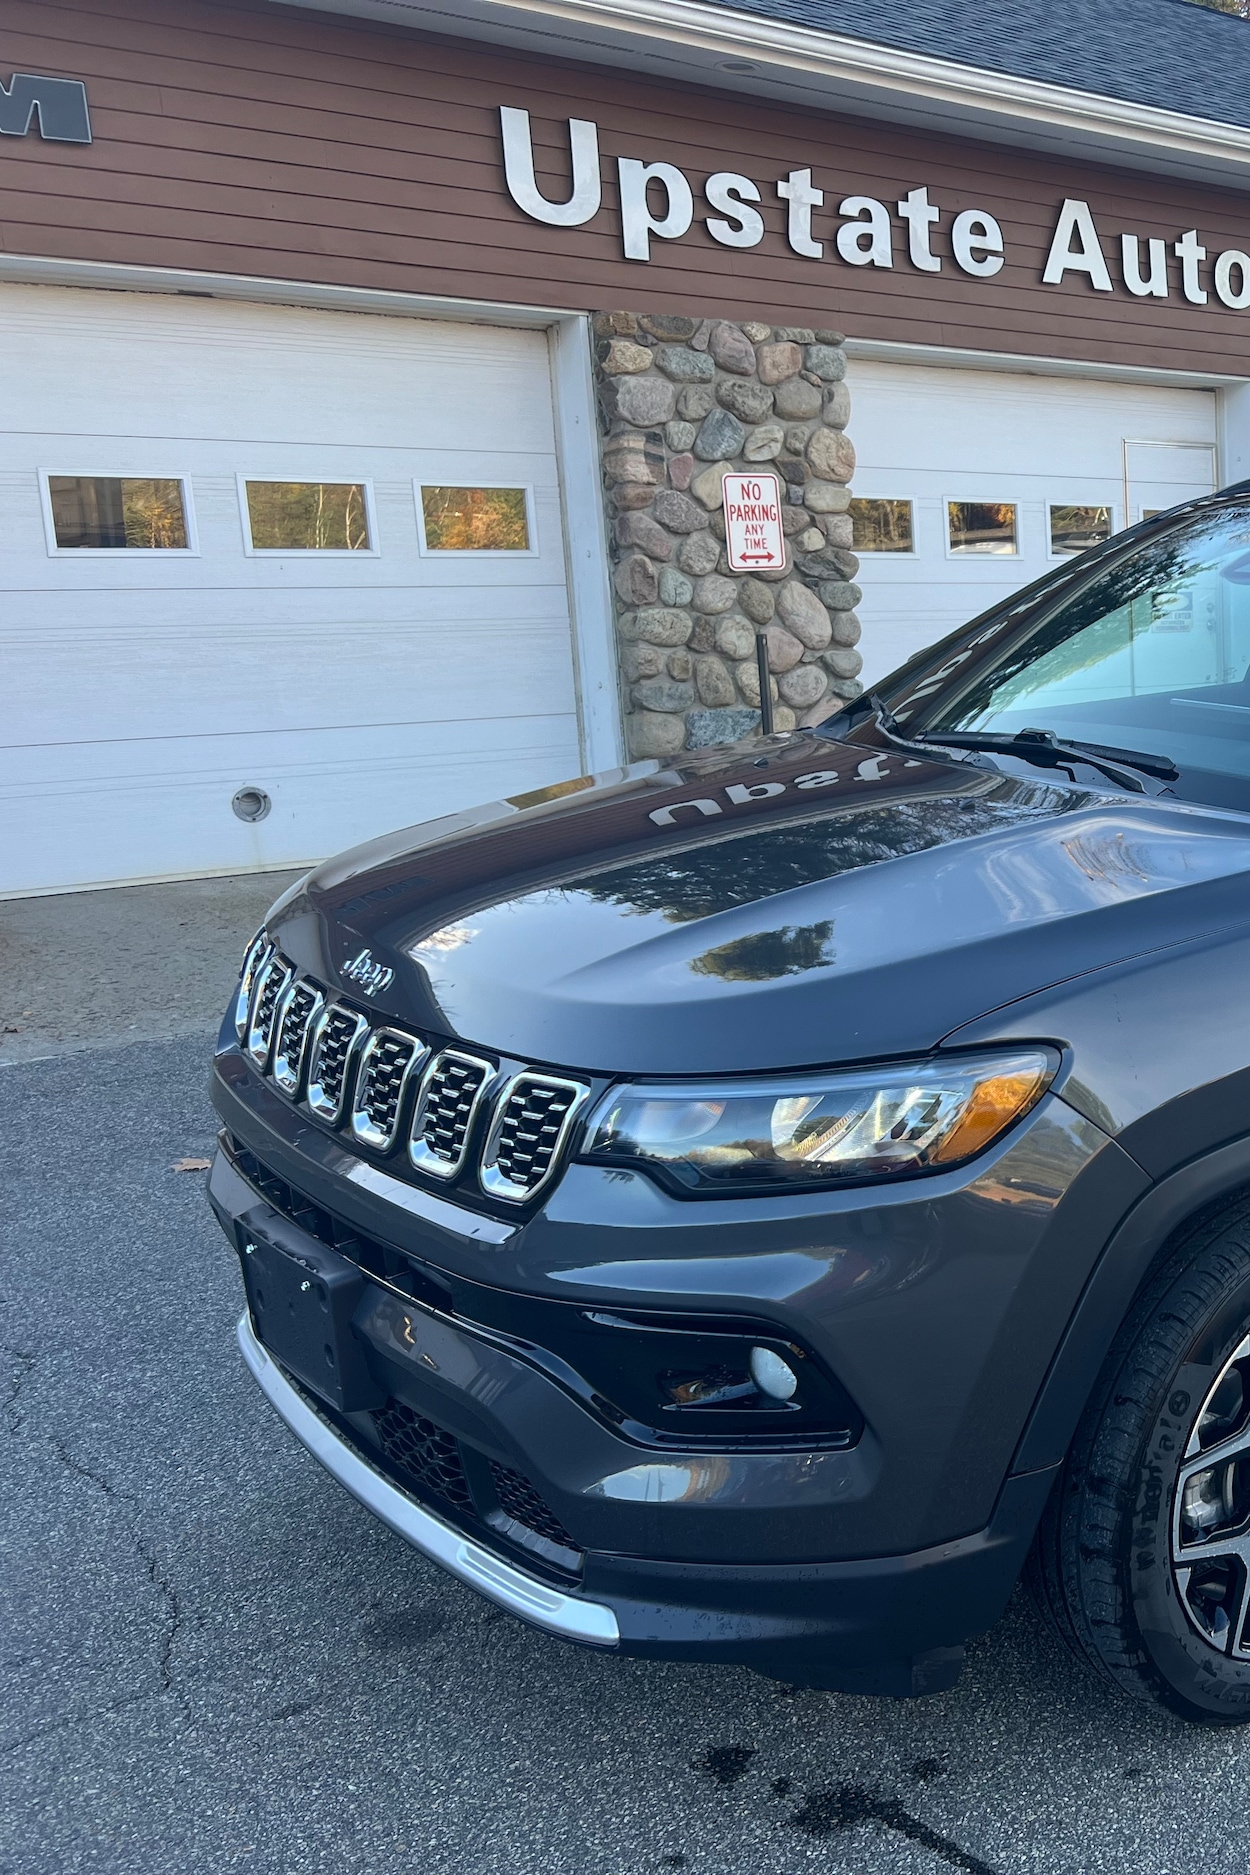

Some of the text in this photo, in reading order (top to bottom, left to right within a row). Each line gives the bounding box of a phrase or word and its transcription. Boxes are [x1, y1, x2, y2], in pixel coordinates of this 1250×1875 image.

[499, 105, 1006, 278] Upstate
[741, 483, 761, 501] NO
[729, 504, 777, 522] PARKING
[744, 524, 765, 536] ANY
[744, 538, 768, 550] TIME
[338, 948, 396, 998] Jeep
